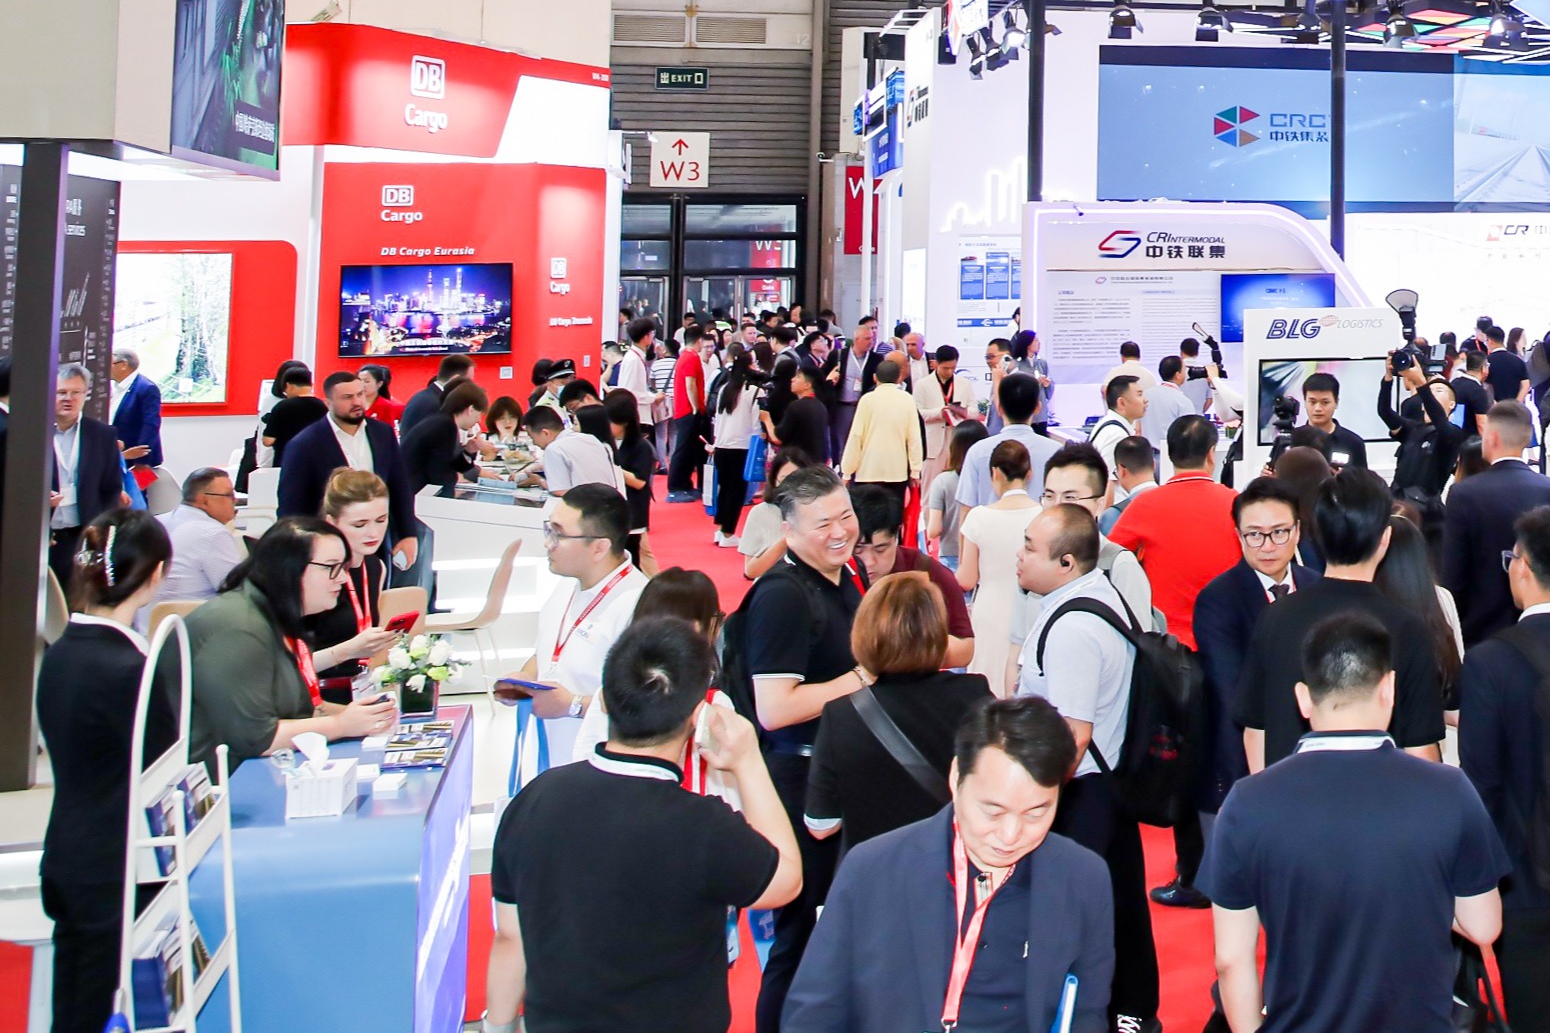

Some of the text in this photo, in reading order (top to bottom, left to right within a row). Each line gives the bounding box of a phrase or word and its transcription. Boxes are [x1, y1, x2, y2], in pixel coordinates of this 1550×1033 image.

[414, 60, 443, 95] DB
[660, 71, 670, 85] 出
[671, 74, 692, 83] EXIT
[404, 103, 447, 133] Cargo
[1270, 113, 1330, 128] CRC
[1270, 130, 1329, 143] 中铁集装
[659, 160, 700, 181] W3
[385, 187, 411, 204] DB
[380, 209, 423, 224] Cargo
[380, 246, 475, 258] DB Cargo Eurasia
[1146, 245, 1226, 259] 中铁联集
[549, 280, 570, 296] Cargo
[1266, 318, 1384, 340] BLG LOGISTICS
